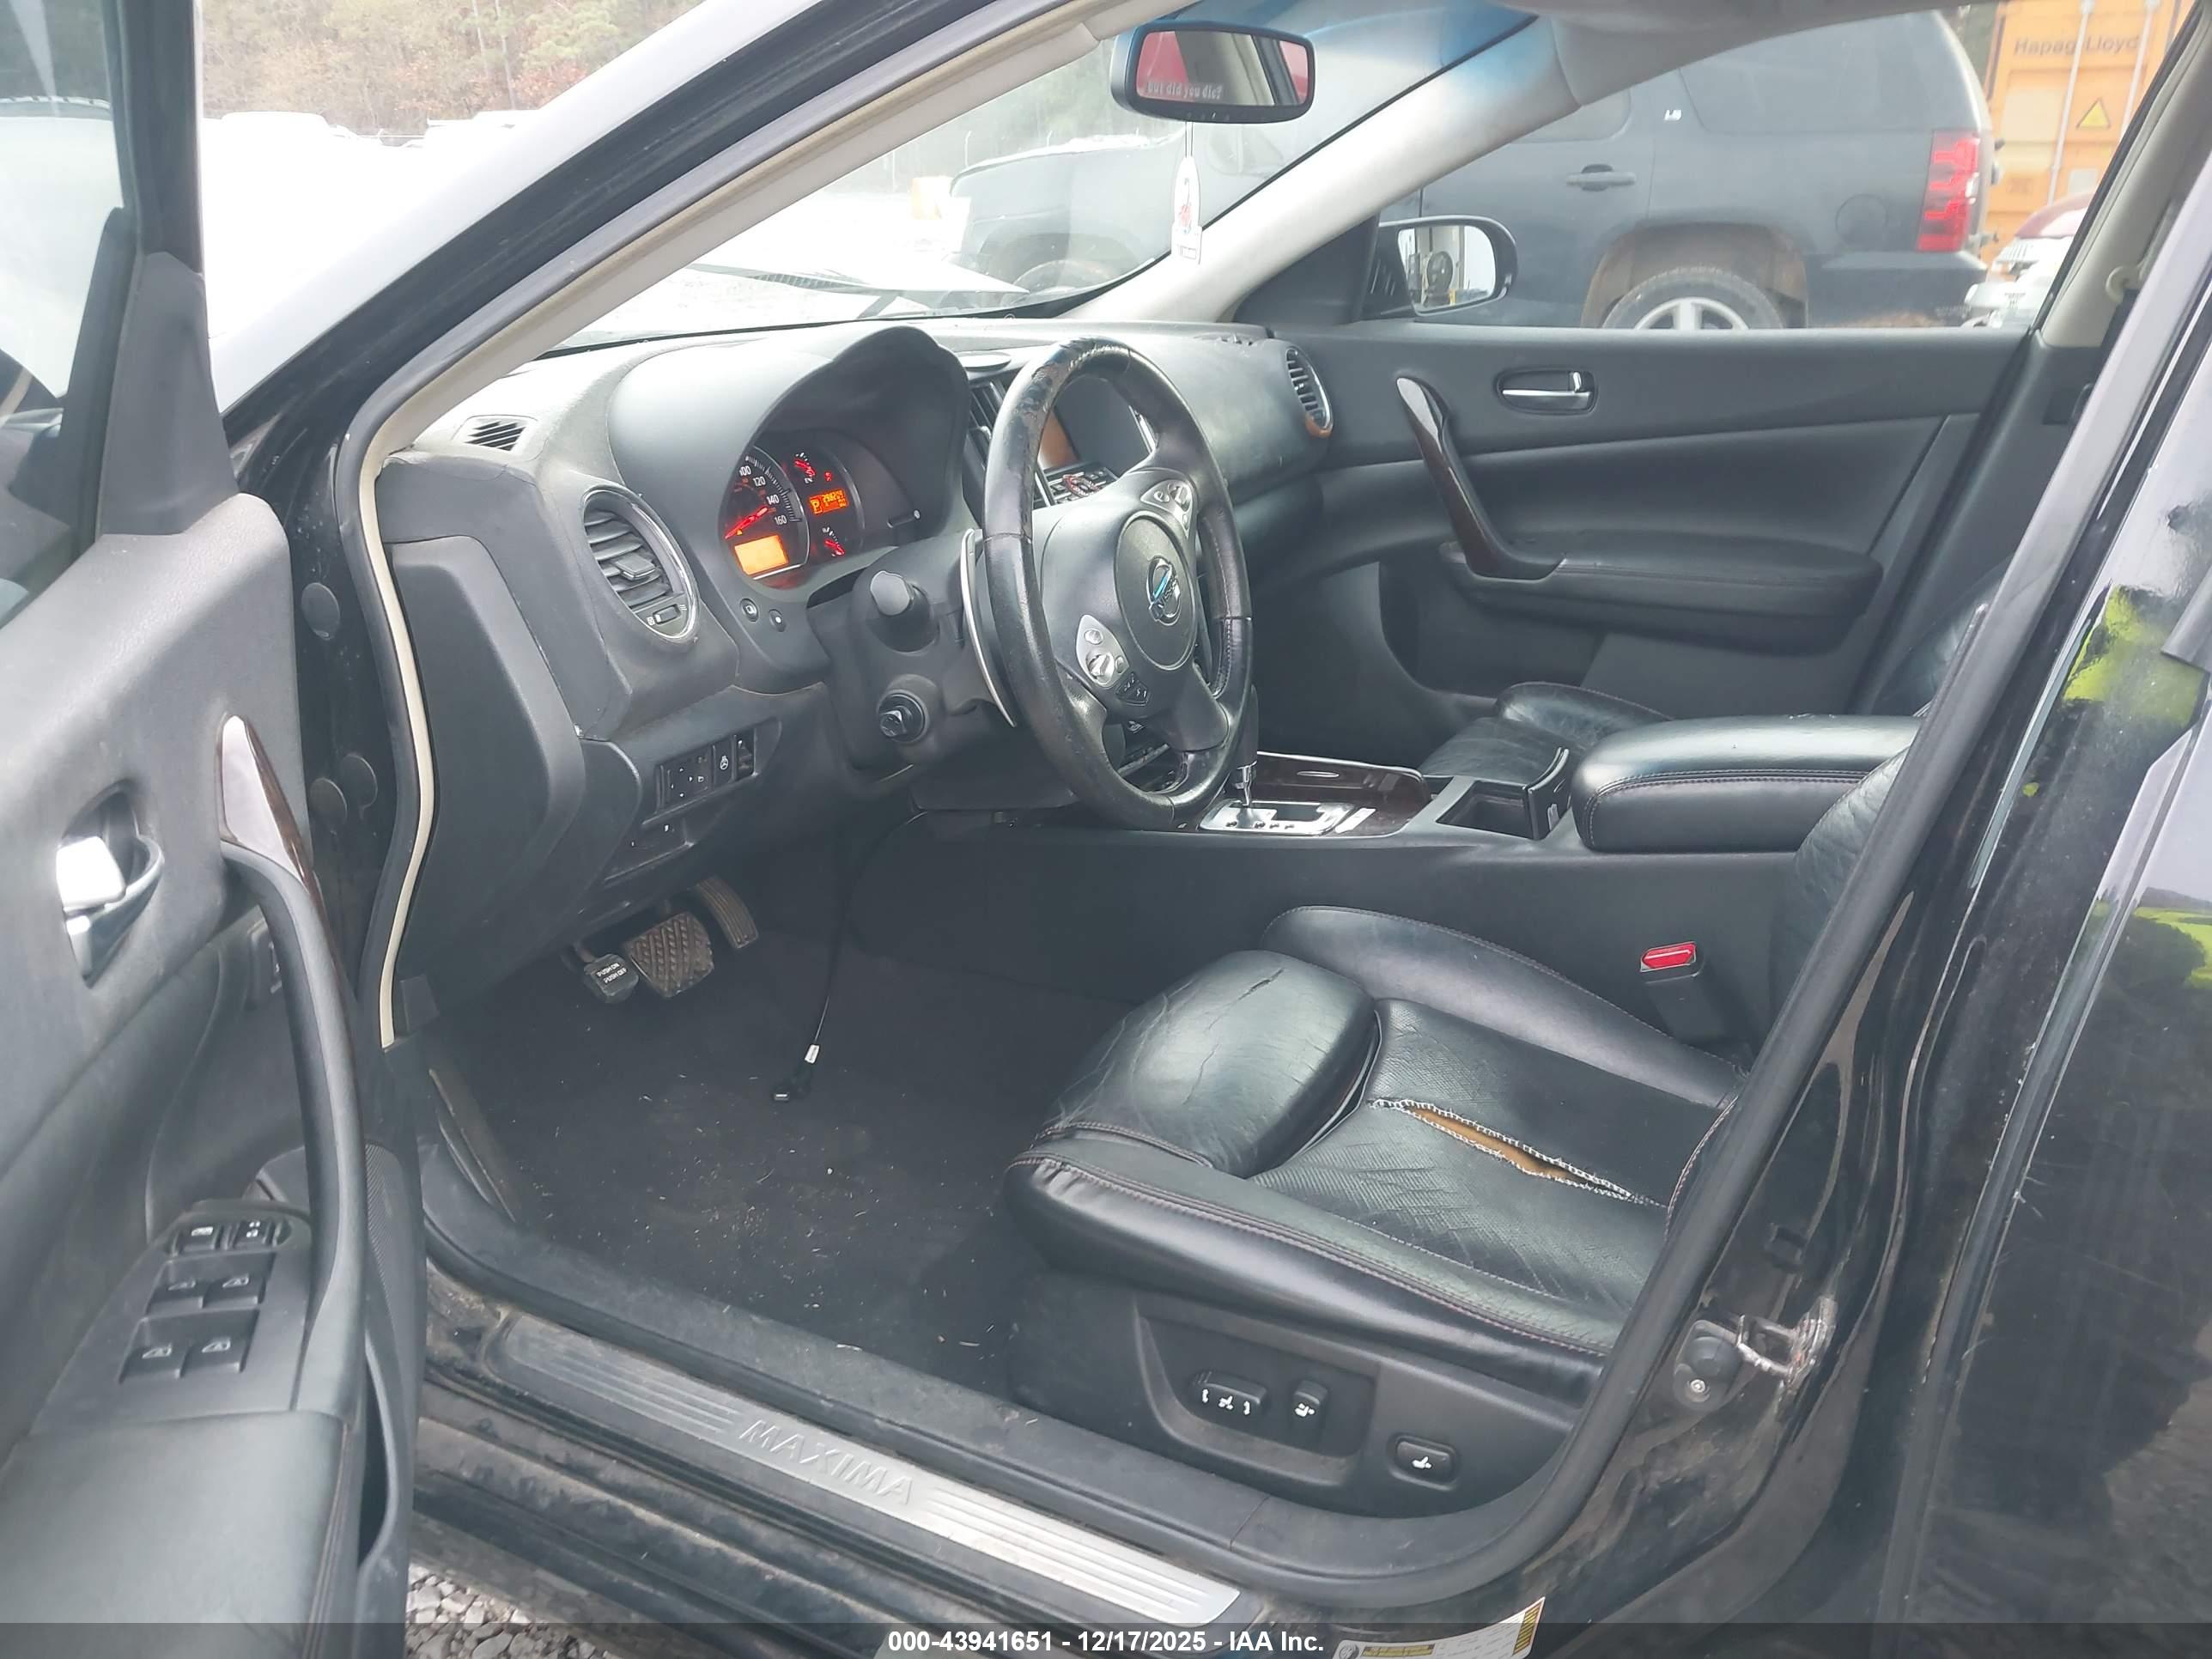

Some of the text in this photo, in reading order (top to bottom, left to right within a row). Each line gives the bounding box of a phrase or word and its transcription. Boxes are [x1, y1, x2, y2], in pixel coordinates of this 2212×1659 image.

[738, 465, 751, 477] 100
[752, 476, 767, 487] 120
[766, 494, 780, 505] 140
[774, 514, 787, 526] 160
[739, 1419, 914, 1505] MAXIMA
